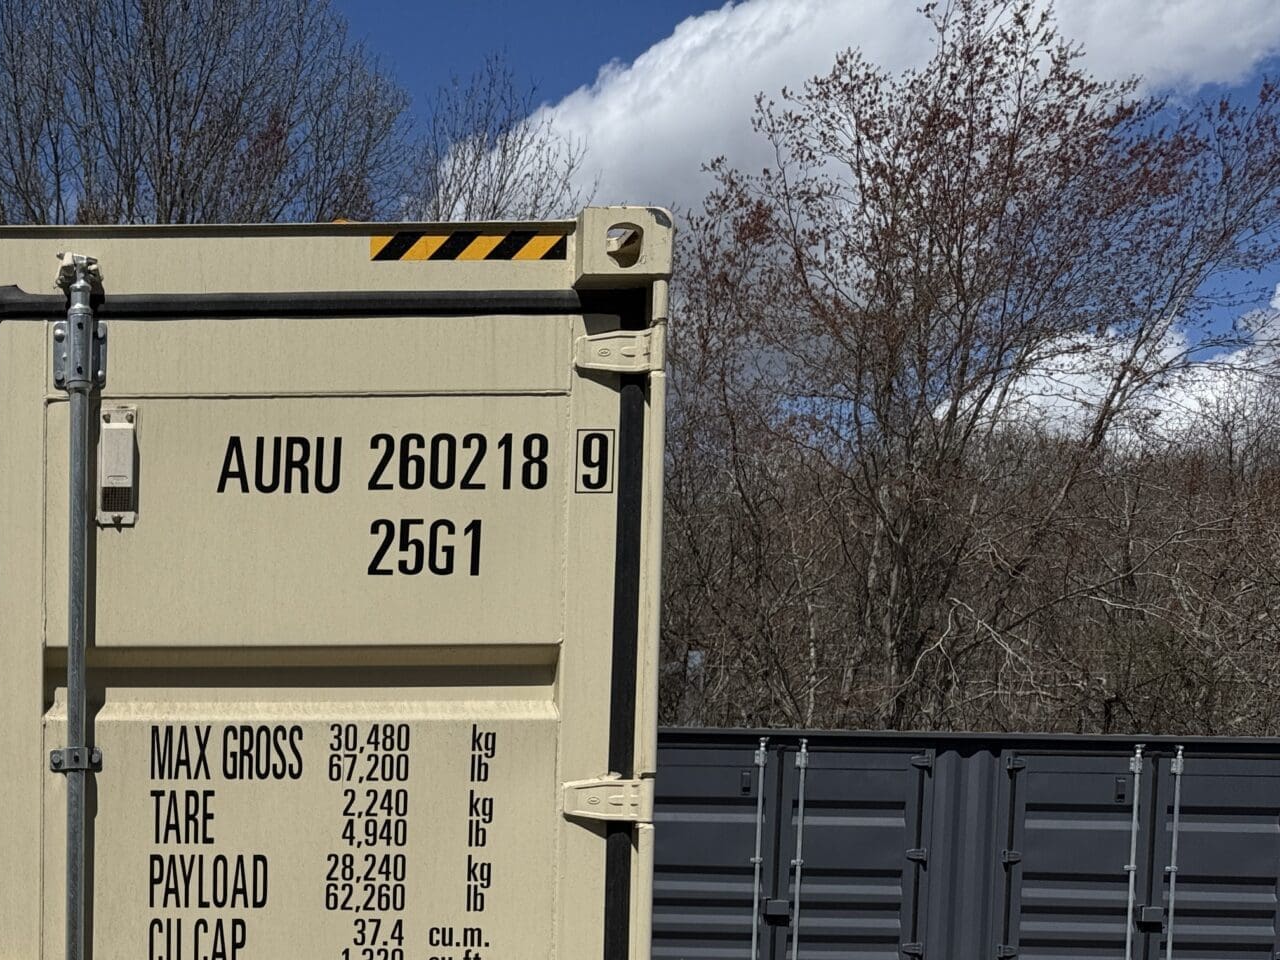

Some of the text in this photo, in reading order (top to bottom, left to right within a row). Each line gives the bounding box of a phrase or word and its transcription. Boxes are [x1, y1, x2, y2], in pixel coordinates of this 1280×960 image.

[217, 432, 609, 494] AURU 260218 9
[368, 519, 482, 576] 25G1
[151, 724, 496, 780] MAX GROSS 30,480 kg
[329, 754, 489, 783] 67,200 lb
[151, 789, 494, 844] TARE 2,240 kg
[342, 819, 486, 848] 4,940 lb
[150, 854, 491, 908] PAYLOAD 28,240 kg
[325, 884, 485, 913] 62,260 lb
[353, 919, 403, 946] 37.4
[429, 926, 490, 947] cu.m.
